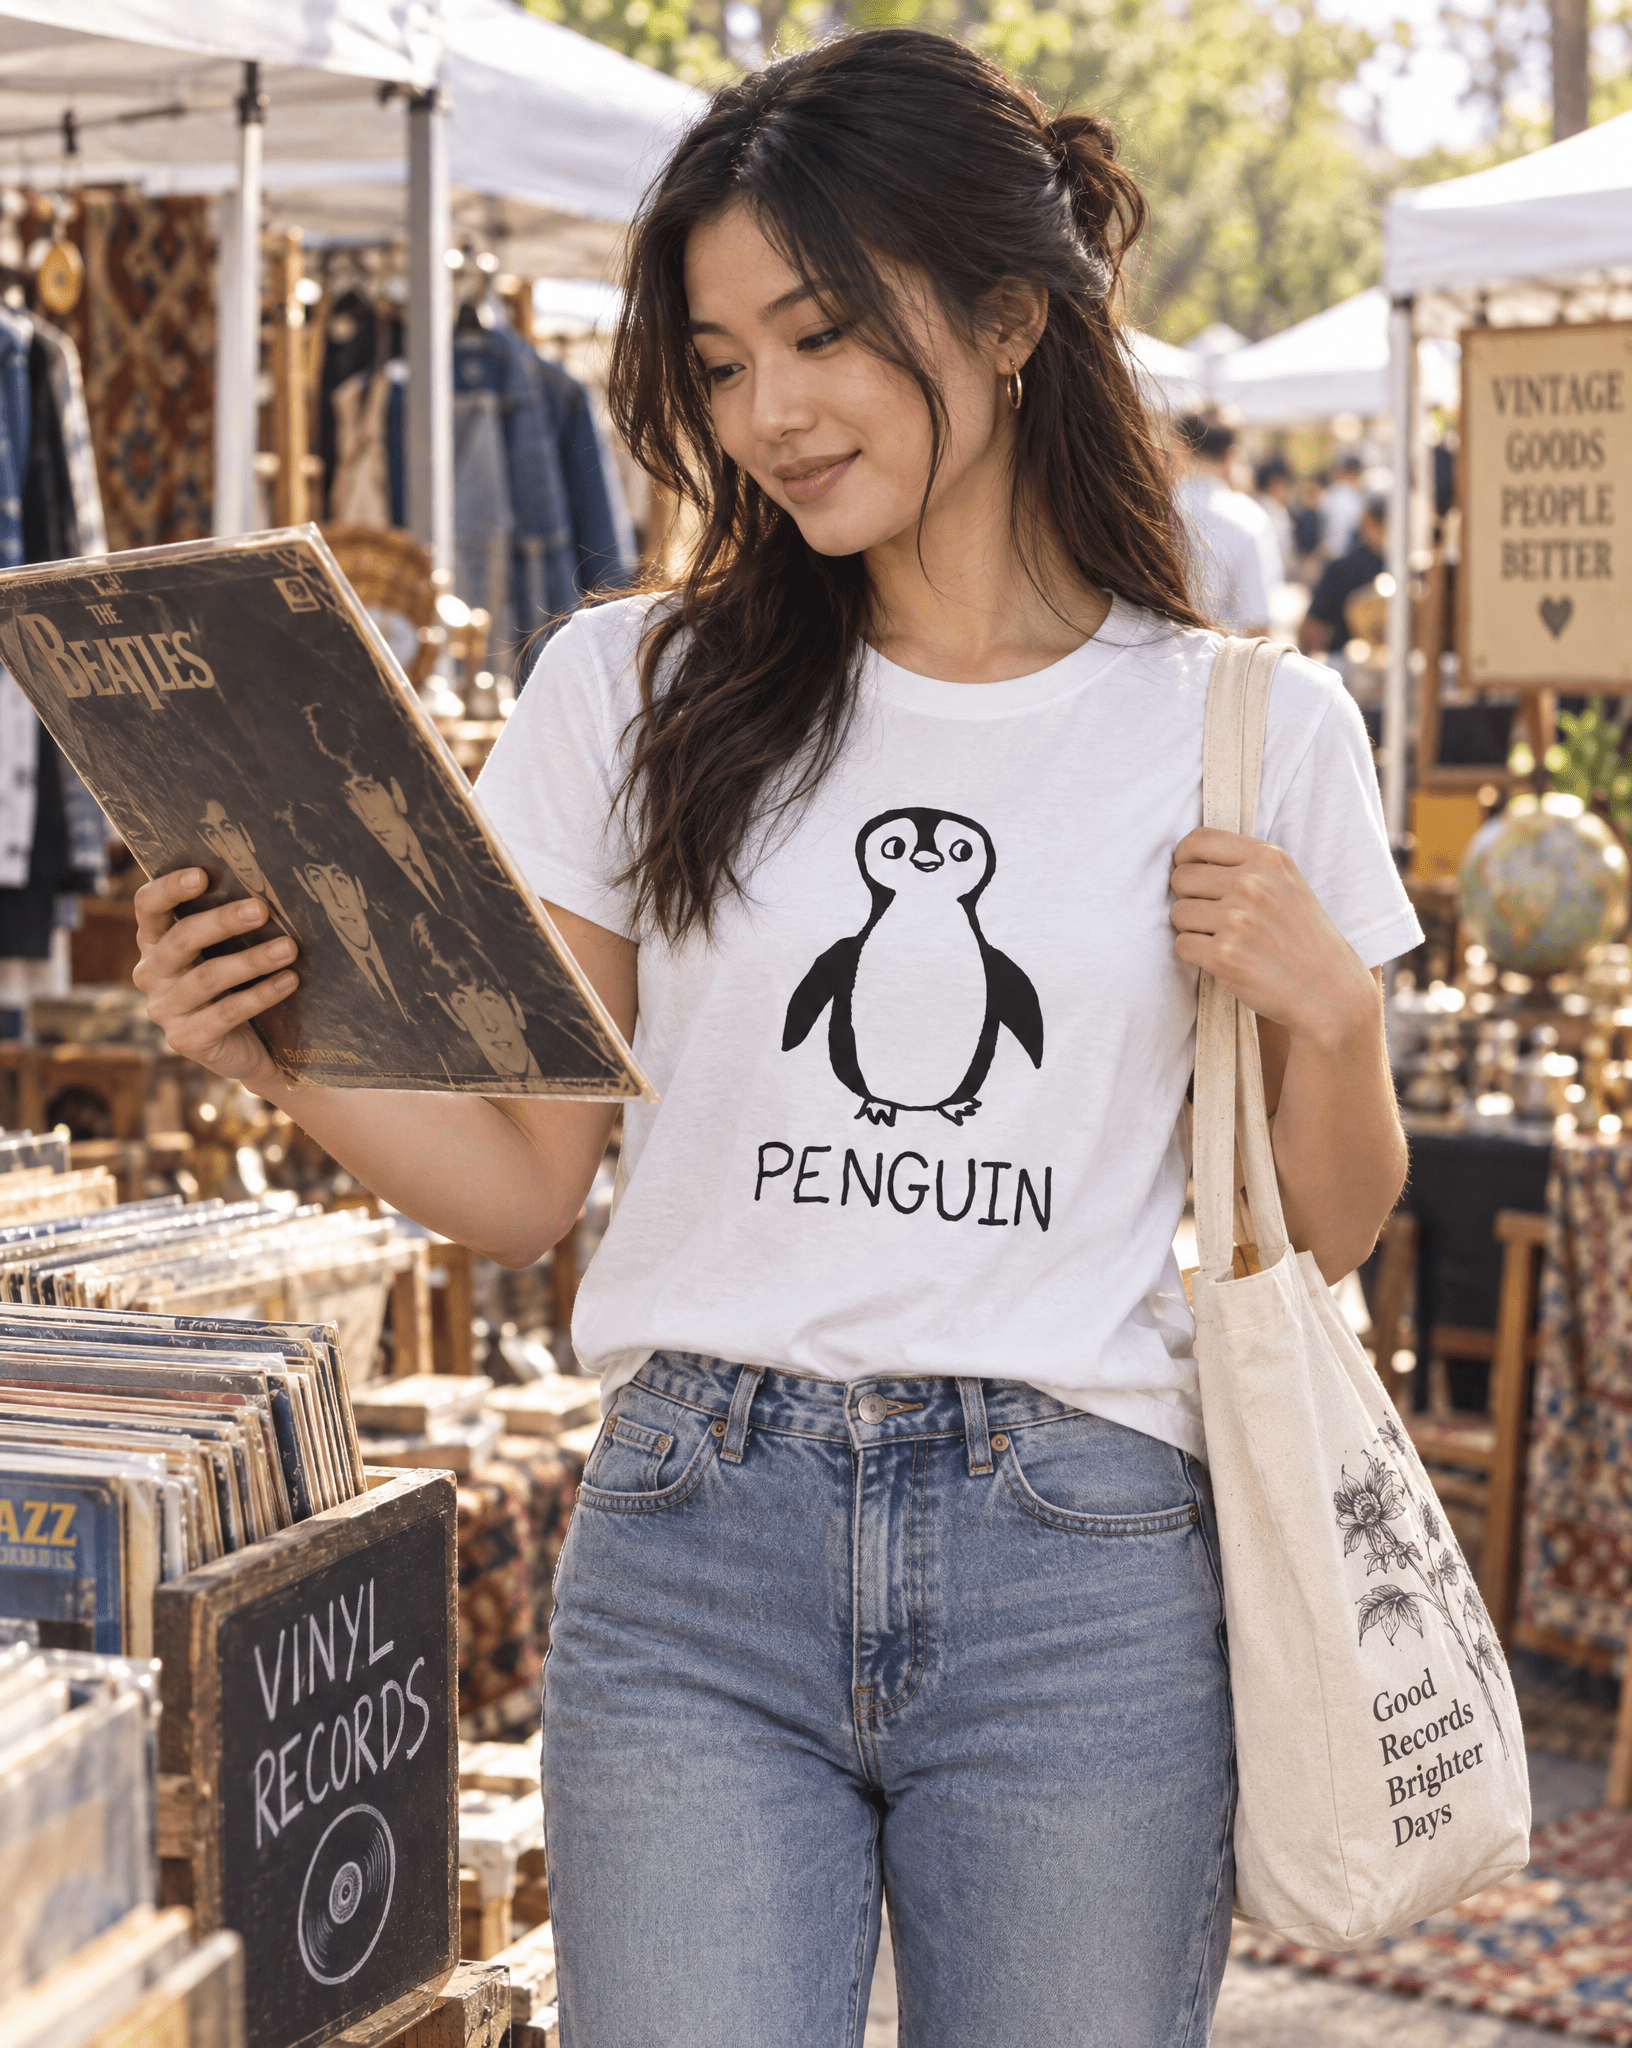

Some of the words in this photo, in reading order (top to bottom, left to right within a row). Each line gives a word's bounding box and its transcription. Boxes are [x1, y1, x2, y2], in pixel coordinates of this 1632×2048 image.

[1492, 368, 1625, 418] VINTAGE
[1504, 427, 1606, 474] GOODS
[1501, 483, 1615, 528] PEOPLE
[1501, 538, 1612, 581] BETTER
[85, 603, 123, 626] THE
[754, 1141, 1053, 1232] PENGUIN
[254, 1577, 395, 1721] VINYL
[1372, 1667, 1438, 1722] Good
[254, 1656, 430, 1849] RECORDS
[1378, 1698, 1474, 1767] Records
[1385, 1742, 1484, 1808] Brighter
[1392, 1803, 1453, 1848] Days
